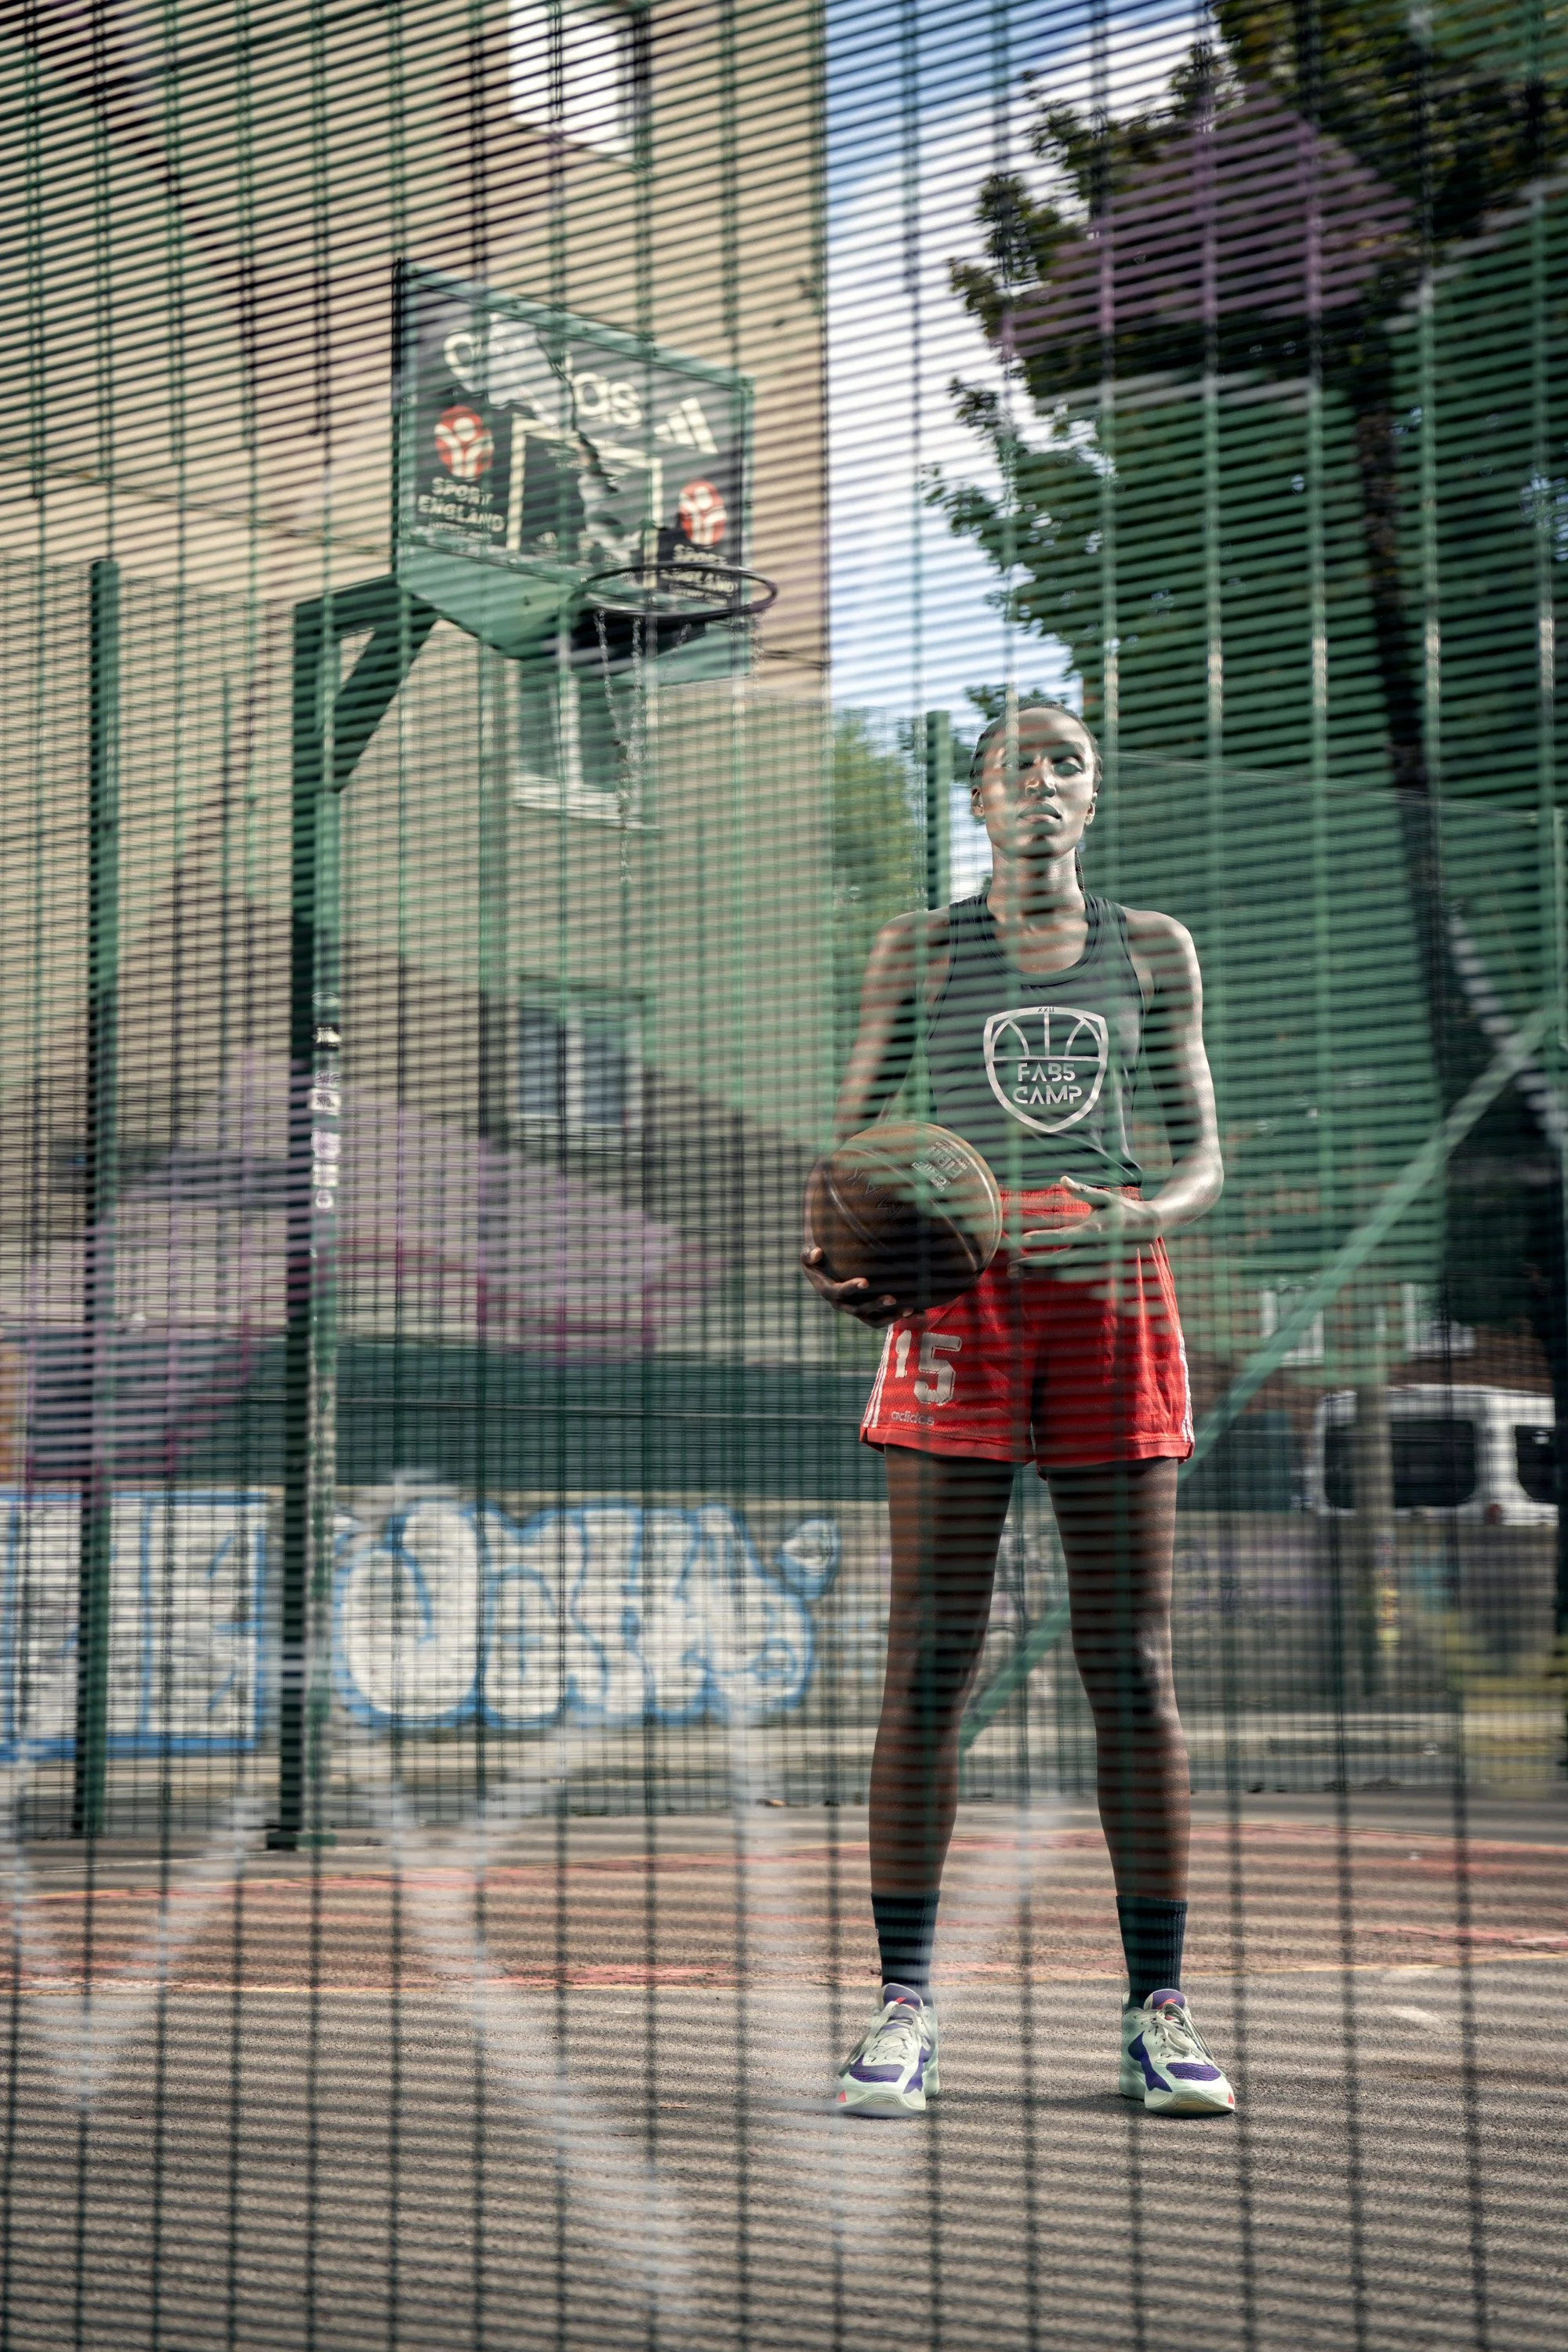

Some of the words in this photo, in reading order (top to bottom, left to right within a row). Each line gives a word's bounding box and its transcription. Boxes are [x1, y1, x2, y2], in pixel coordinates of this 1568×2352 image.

[431, 476, 495, 506] SPORT
[417, 494, 506, 532] ENGLAND
[1018, 1062, 1076, 1082] FAB5
[1012, 1085, 1082, 1105] CAMP
[895, 1330, 962, 1406] 15
[891, 1410, 935, 1426] adidas
